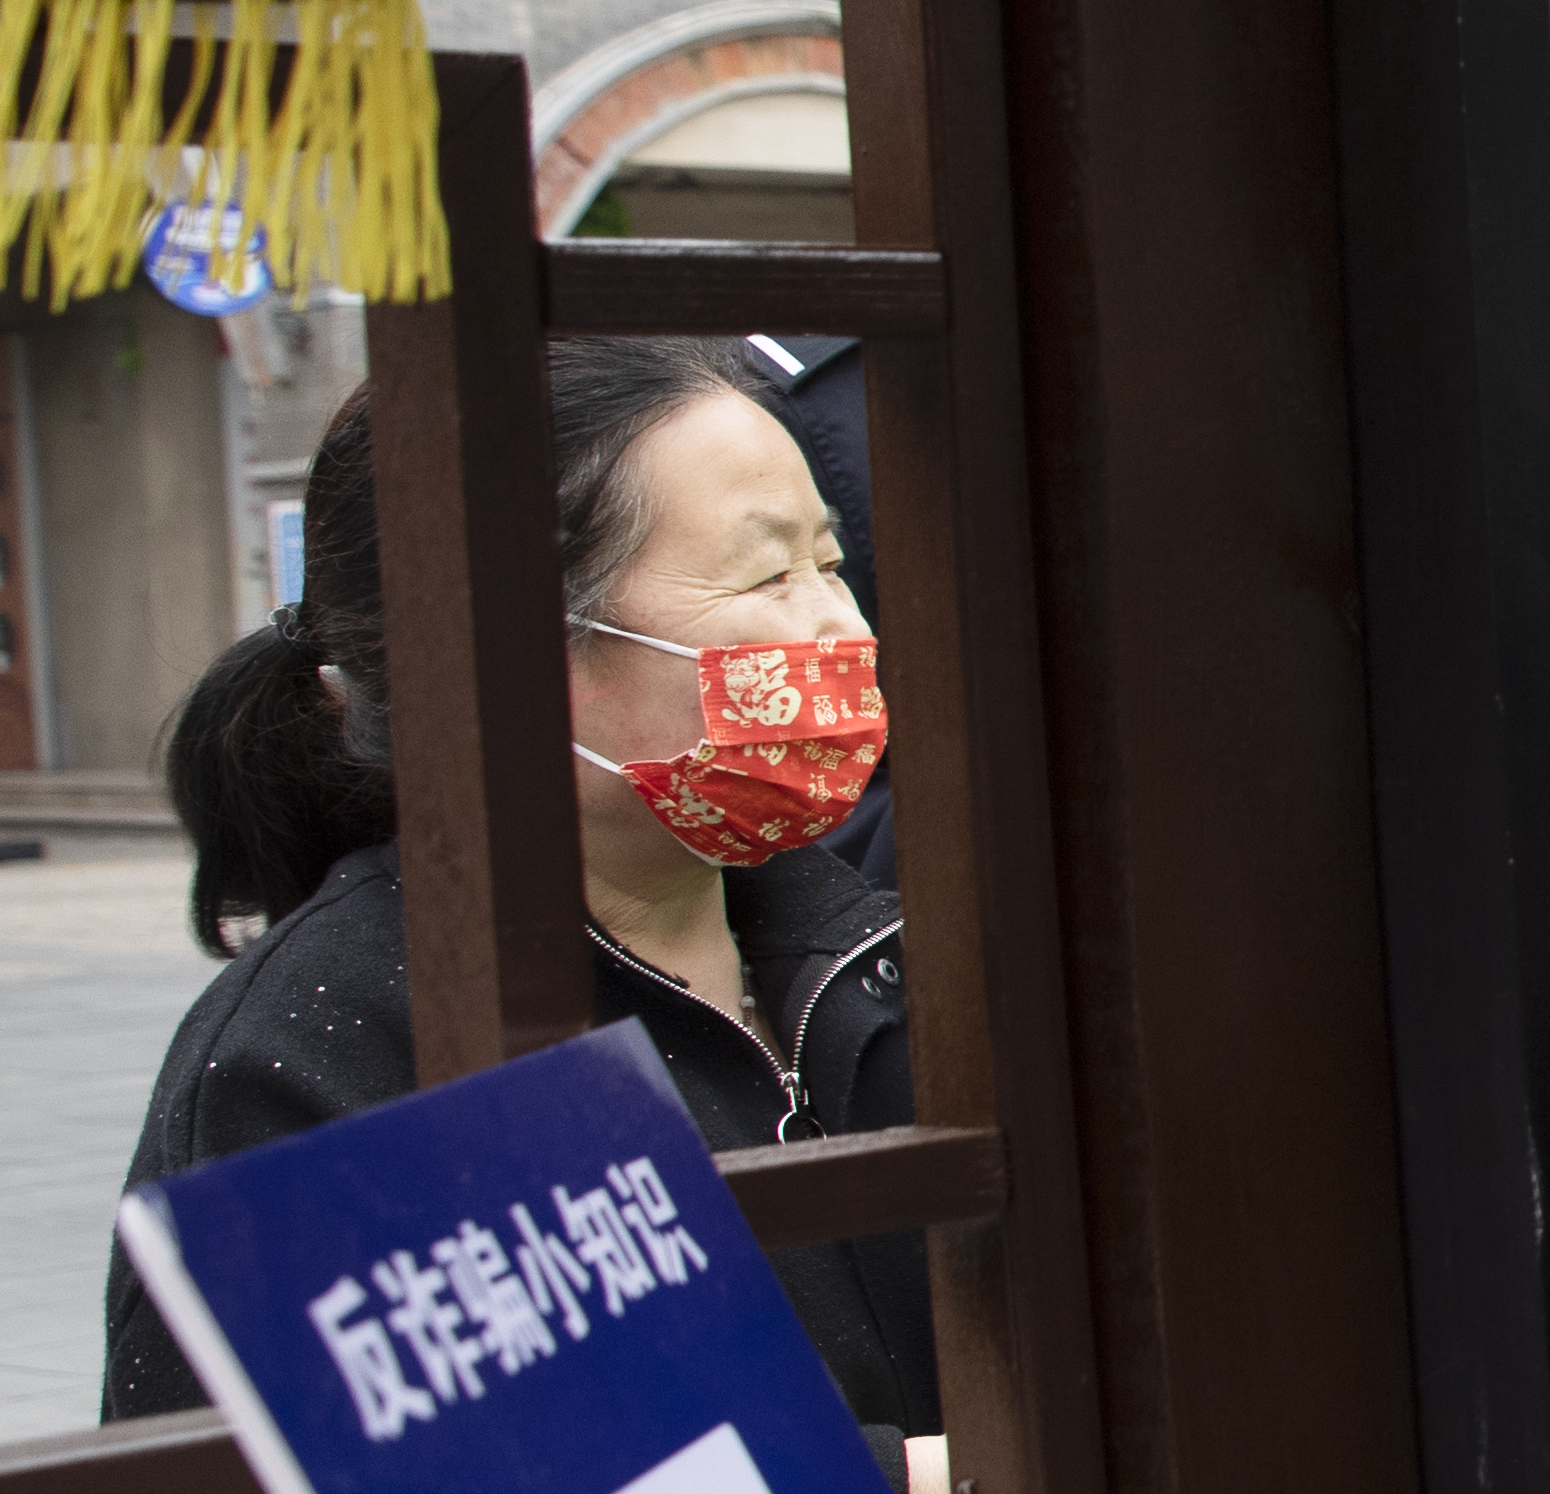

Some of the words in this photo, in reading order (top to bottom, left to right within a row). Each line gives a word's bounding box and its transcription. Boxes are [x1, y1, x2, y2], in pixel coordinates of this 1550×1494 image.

[306, 1156, 710, 1441] 反诈骗小知识
